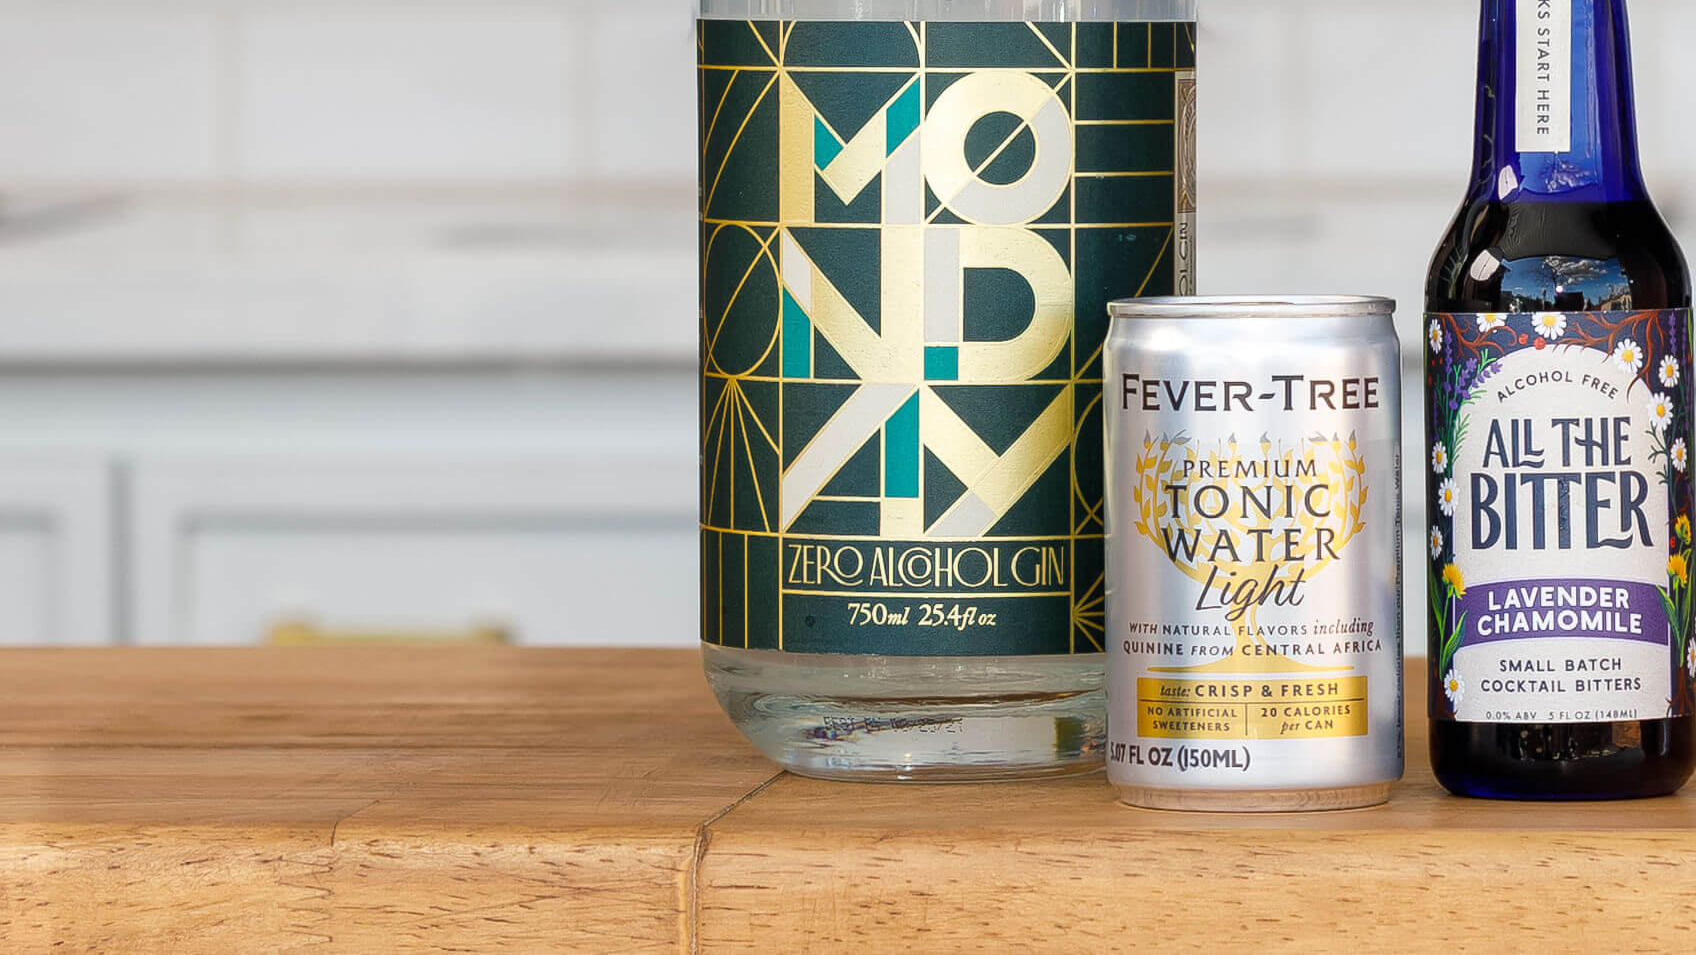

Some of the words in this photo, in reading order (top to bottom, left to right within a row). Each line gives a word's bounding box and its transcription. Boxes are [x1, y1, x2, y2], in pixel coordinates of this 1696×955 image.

[1536, 27, 1551, 82] START
[1536, 89, 1550, 135] HERE
[1122, 373, 1379, 412] FEVER-TREE
[1496, 370, 1573, 404] ALCOHOL
[1581, 374, 1620, 402] FREE
[1482, 417, 1545, 468] ALL
[1551, 416, 1632, 467] THE
[1183, 459, 1317, 479] PREMIUM
[1166, 484, 1331, 519] TONIC
[1470, 470, 1653, 551] BITTER
[1162, 526, 1340, 563] WATER
[787, 543, 864, 586] ZERO
[869, 546, 1008, 588] ALCOHOL
[1011, 546, 1064, 587] GIN
[1195, 564, 1306, 622] Light
[1487, 585, 1630, 612] LAVENDER
[848, 602, 910, 626] 750ml
[1476, 608, 1643, 637] CHAMOMILE
[1129, 621, 1158, 635] WITH
[1162, 622, 1231, 636] NATURAL
[1238, 624, 1308, 636] FLAVORS
[1313, 619, 1375, 637] including
[1122, 640, 1184, 656] QUININE
[1190, 645, 1234, 656] FROM
[1241, 644, 1326, 656] CENTRAL
[1332, 639, 1383, 654] AFRICA
[1498, 658, 1555, 673] SMALL
[1564, 657, 1622, 672] BATCH
[1160, 685, 1191, 698] taste:
[1194, 684, 1253, 698] CRISP
[1260, 684, 1273, 698] &
[1281, 682, 1340, 697] FRESH
[1480, 677, 1566, 693] COCKTAIL
[1574, 676, 1642, 693] BITTERS
[1147, 706, 1164, 717] NO
[1167, 707, 1238, 718] ARTIFICIAL
[1260, 707, 1278, 718] 20
[1283, 704, 1351, 717] CALORIES
[1485, 710, 1512, 720] 0.0%
[1515, 710, 1537, 720] ABV
[1549, 710, 1555, 720] 5
[1559, 710, 1571, 720] FL
[1574, 710, 1591, 720] OZ
[1595, 708, 1638, 720] (148ML)
[1152, 720, 1231, 732] SWEETENERS
[1280, 721, 1302, 735] per
[1305, 719, 1334, 730] CAN
[1128, 744, 1145, 765] FL
[1148, 746, 1173, 767] OZ
[1177, 744, 1251, 772] (150ML)
